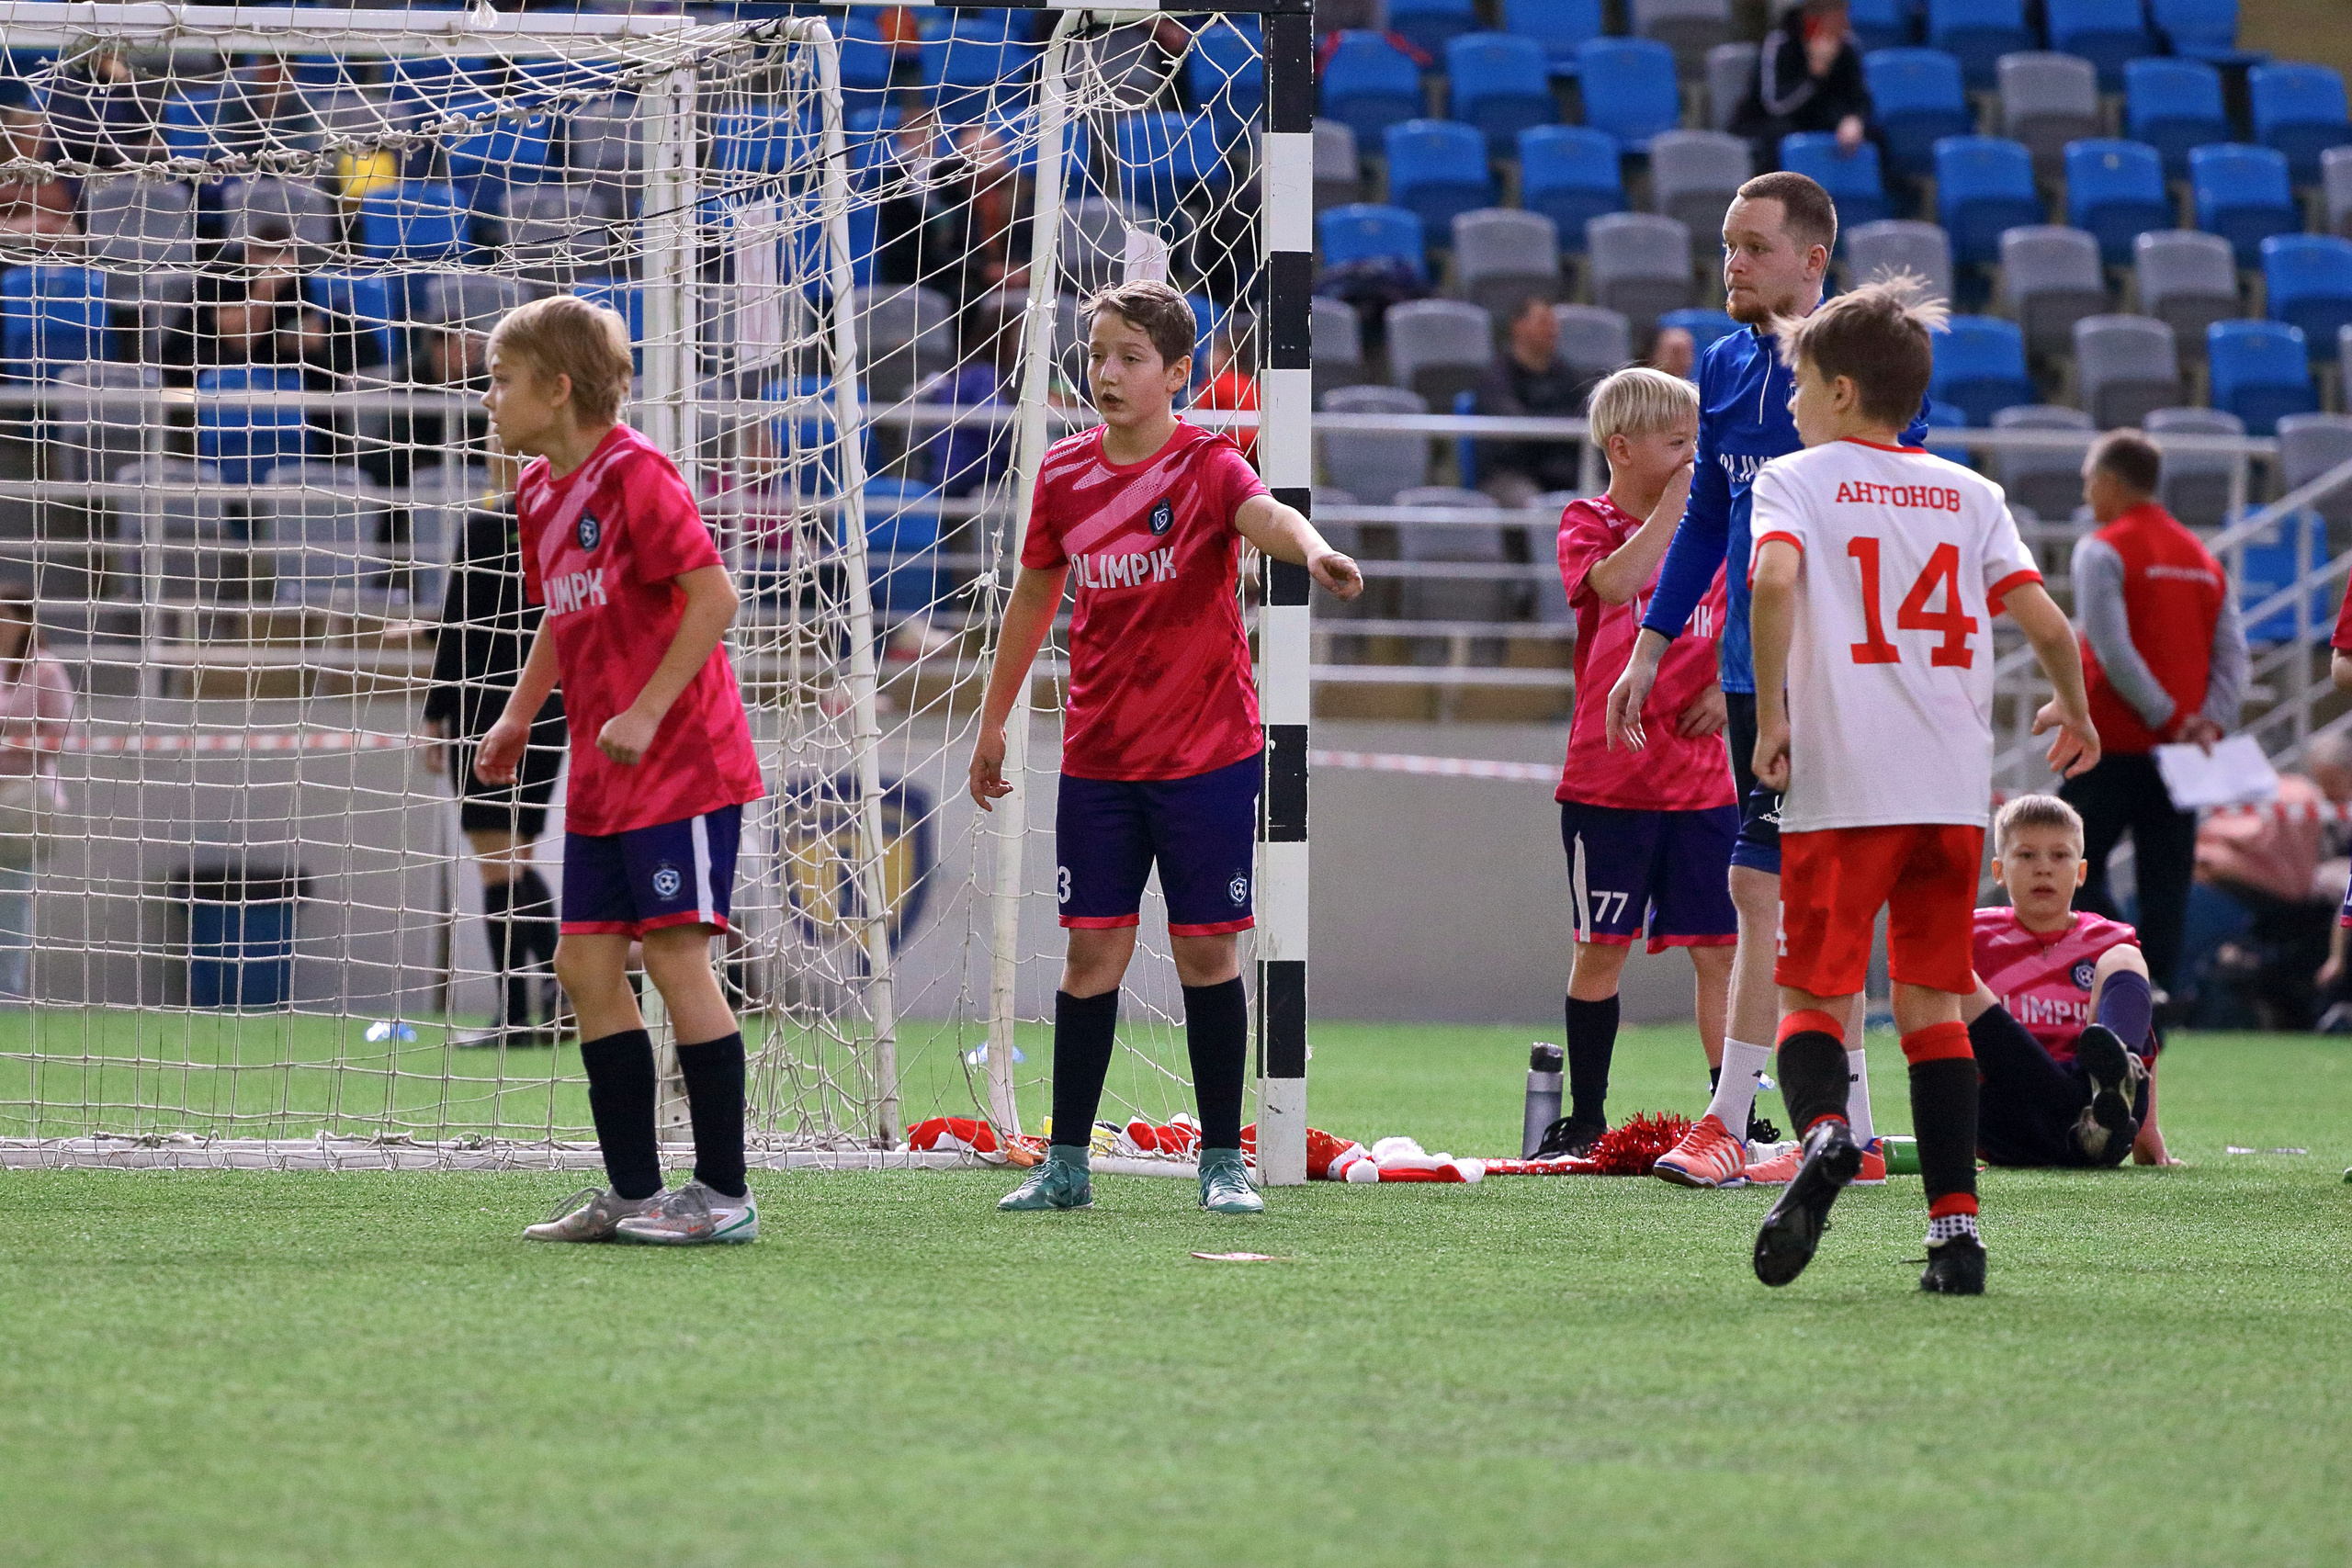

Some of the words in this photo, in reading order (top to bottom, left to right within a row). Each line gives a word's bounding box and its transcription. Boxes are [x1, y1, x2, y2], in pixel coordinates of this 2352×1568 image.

[1836, 480, 1961, 513] АНТОНОВ
[1070, 546, 1177, 589] OLIMPIK
[1847, 536, 1979, 670] 14
[1590, 890, 1629, 924] 77
